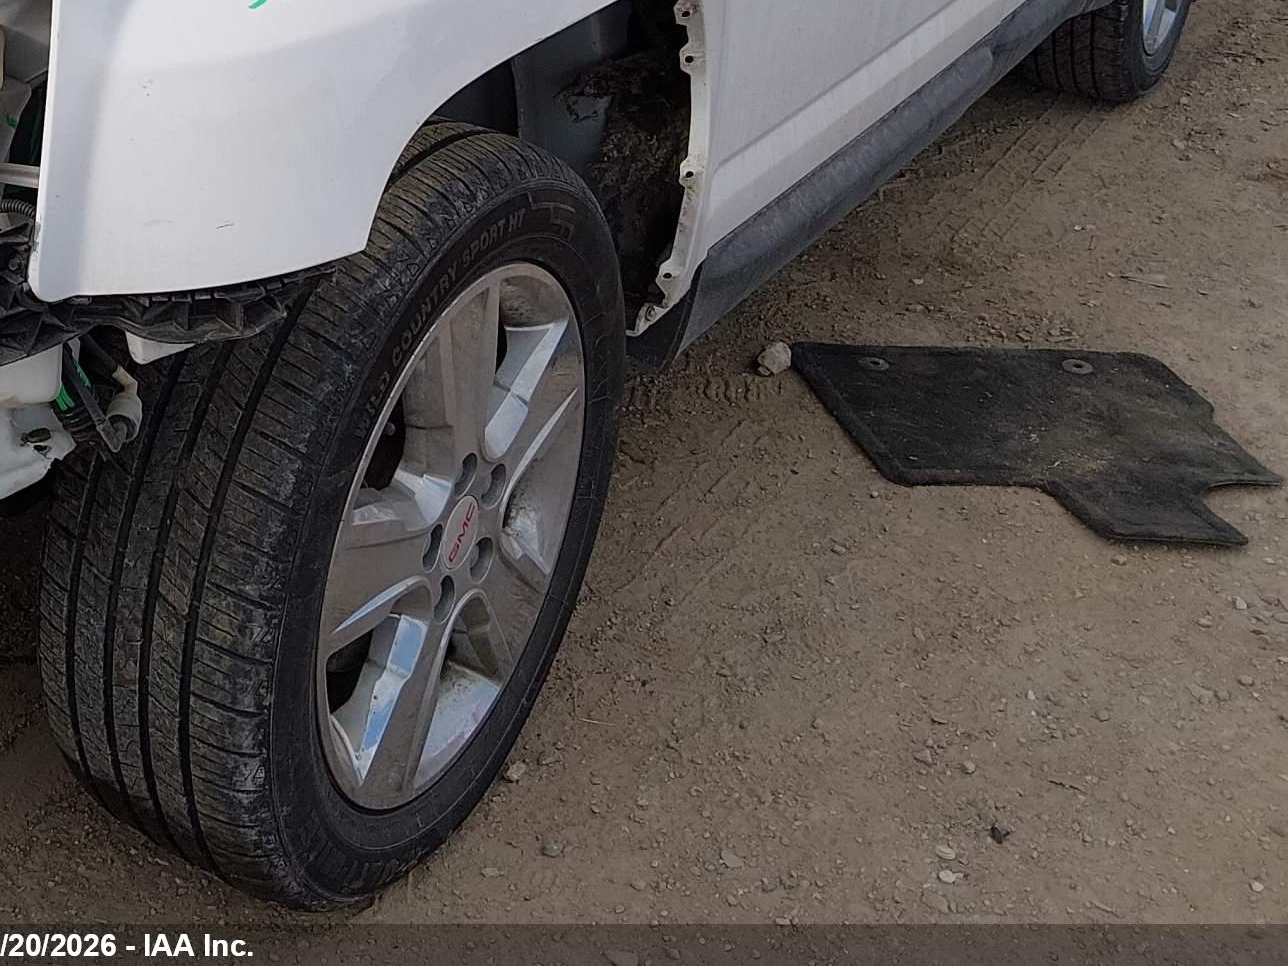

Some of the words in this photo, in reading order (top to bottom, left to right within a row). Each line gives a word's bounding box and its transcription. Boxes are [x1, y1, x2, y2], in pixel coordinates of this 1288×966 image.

[391, 262, 458, 368] COUNTRY
[461, 218, 509, 268] SPORT
[448, 502, 476, 563] GMC
